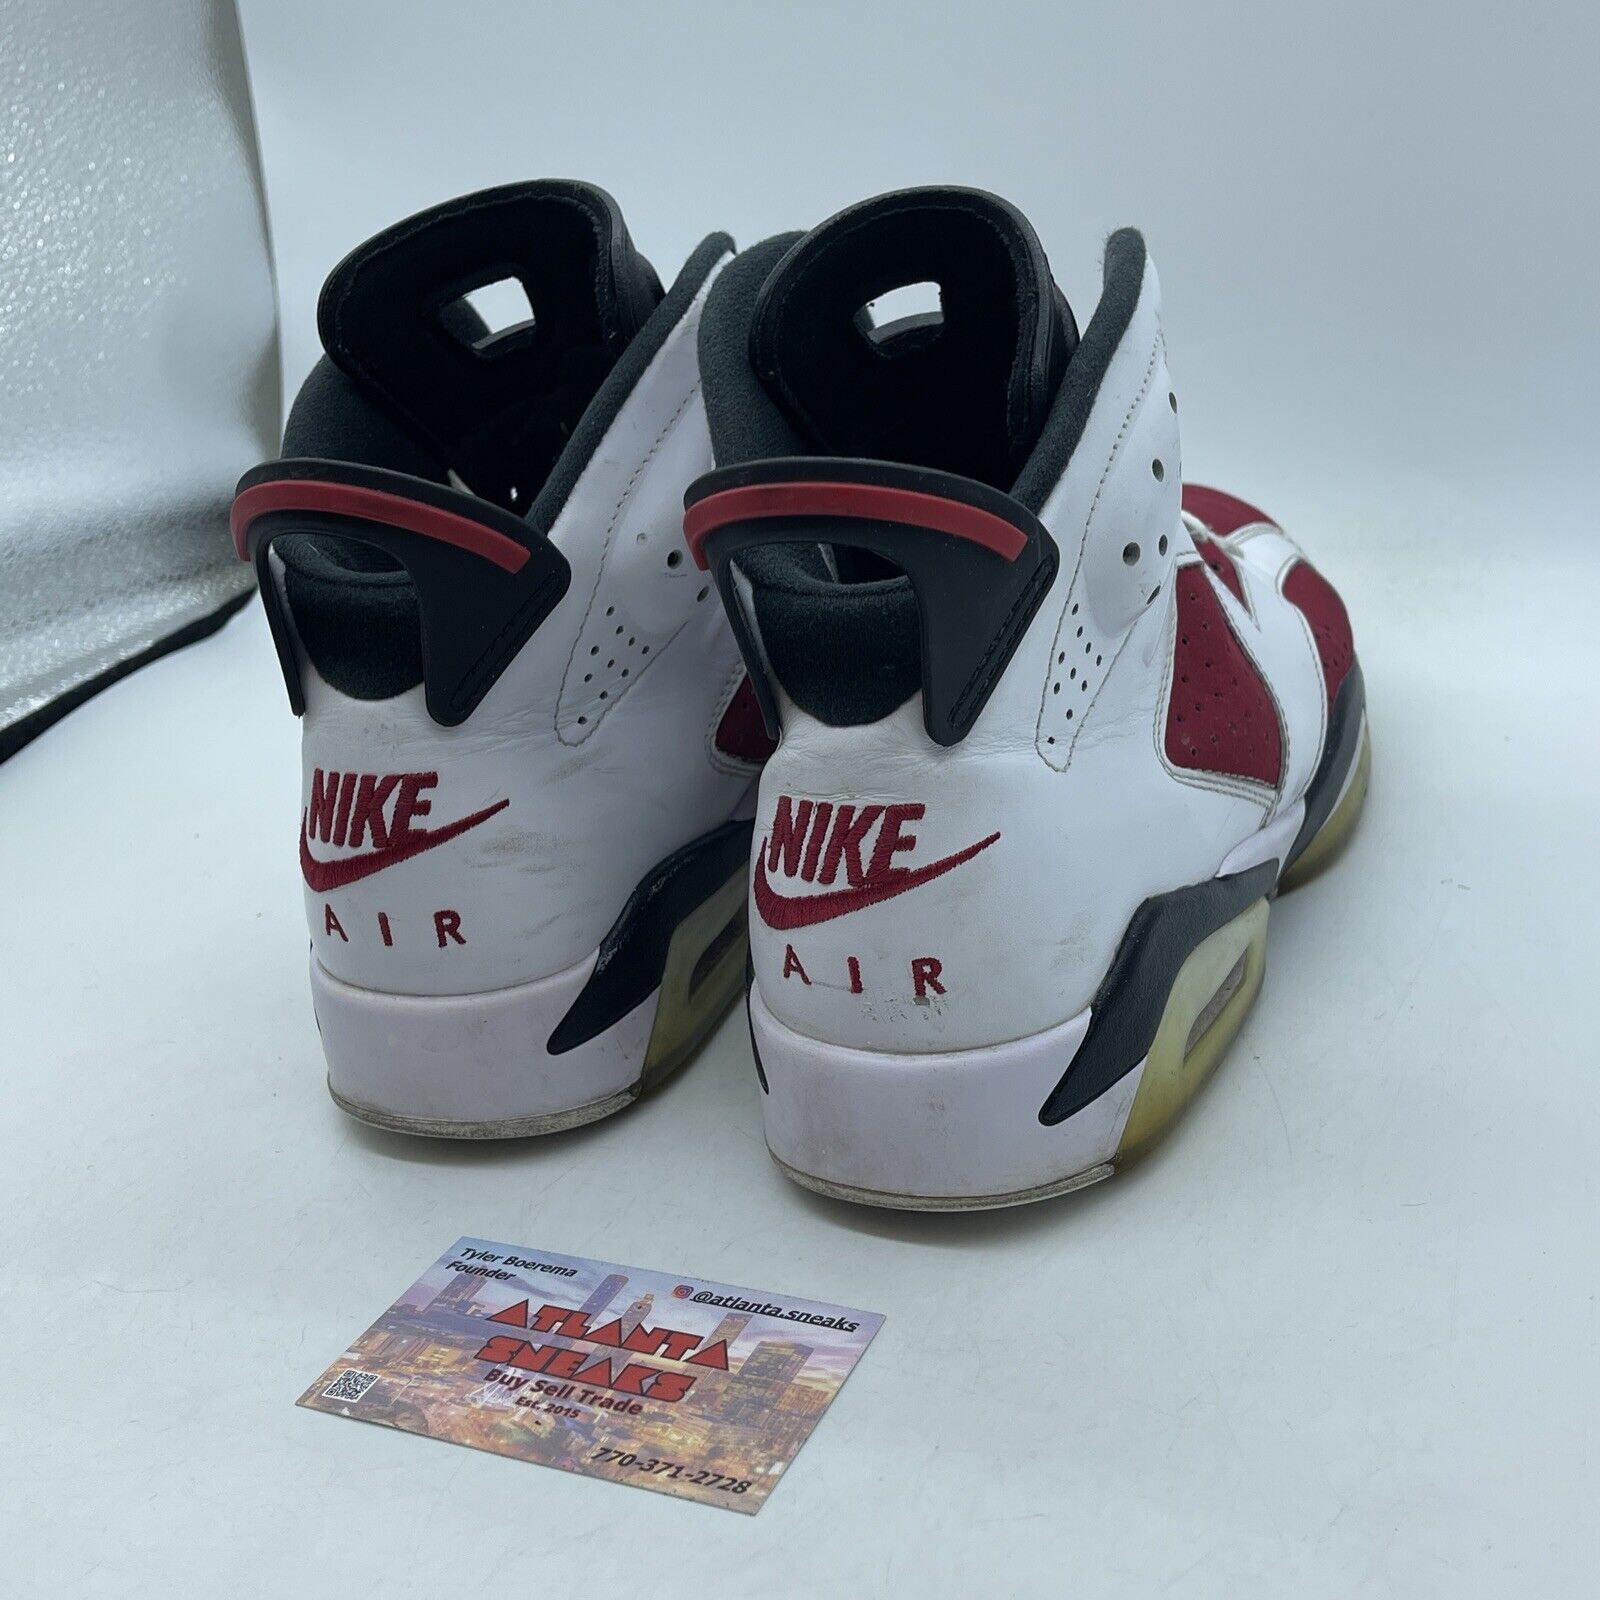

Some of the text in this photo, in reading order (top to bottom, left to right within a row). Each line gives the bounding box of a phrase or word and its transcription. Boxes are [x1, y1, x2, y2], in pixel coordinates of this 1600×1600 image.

[308, 768, 439, 849] NIKE
[767, 795, 926, 887] NIKE
[324, 903, 467, 948] AIR
[783, 943, 948, 998] AIR
[445, 1260, 517, 1281] Founder
[460, 1247, 579, 1278] Tyler Boerema
[485, 1298, 730, 1372] ATLANTA
[690, 1290, 861, 1333] @atlanta.sneaks
[473, 1335, 698, 1403] SNEAKS
[484, 1368, 644, 1416] Buy Sell Trade
[515, 1396, 581, 1419] Est. 2015
[590, 1446, 753, 1495] 770-371-2728
